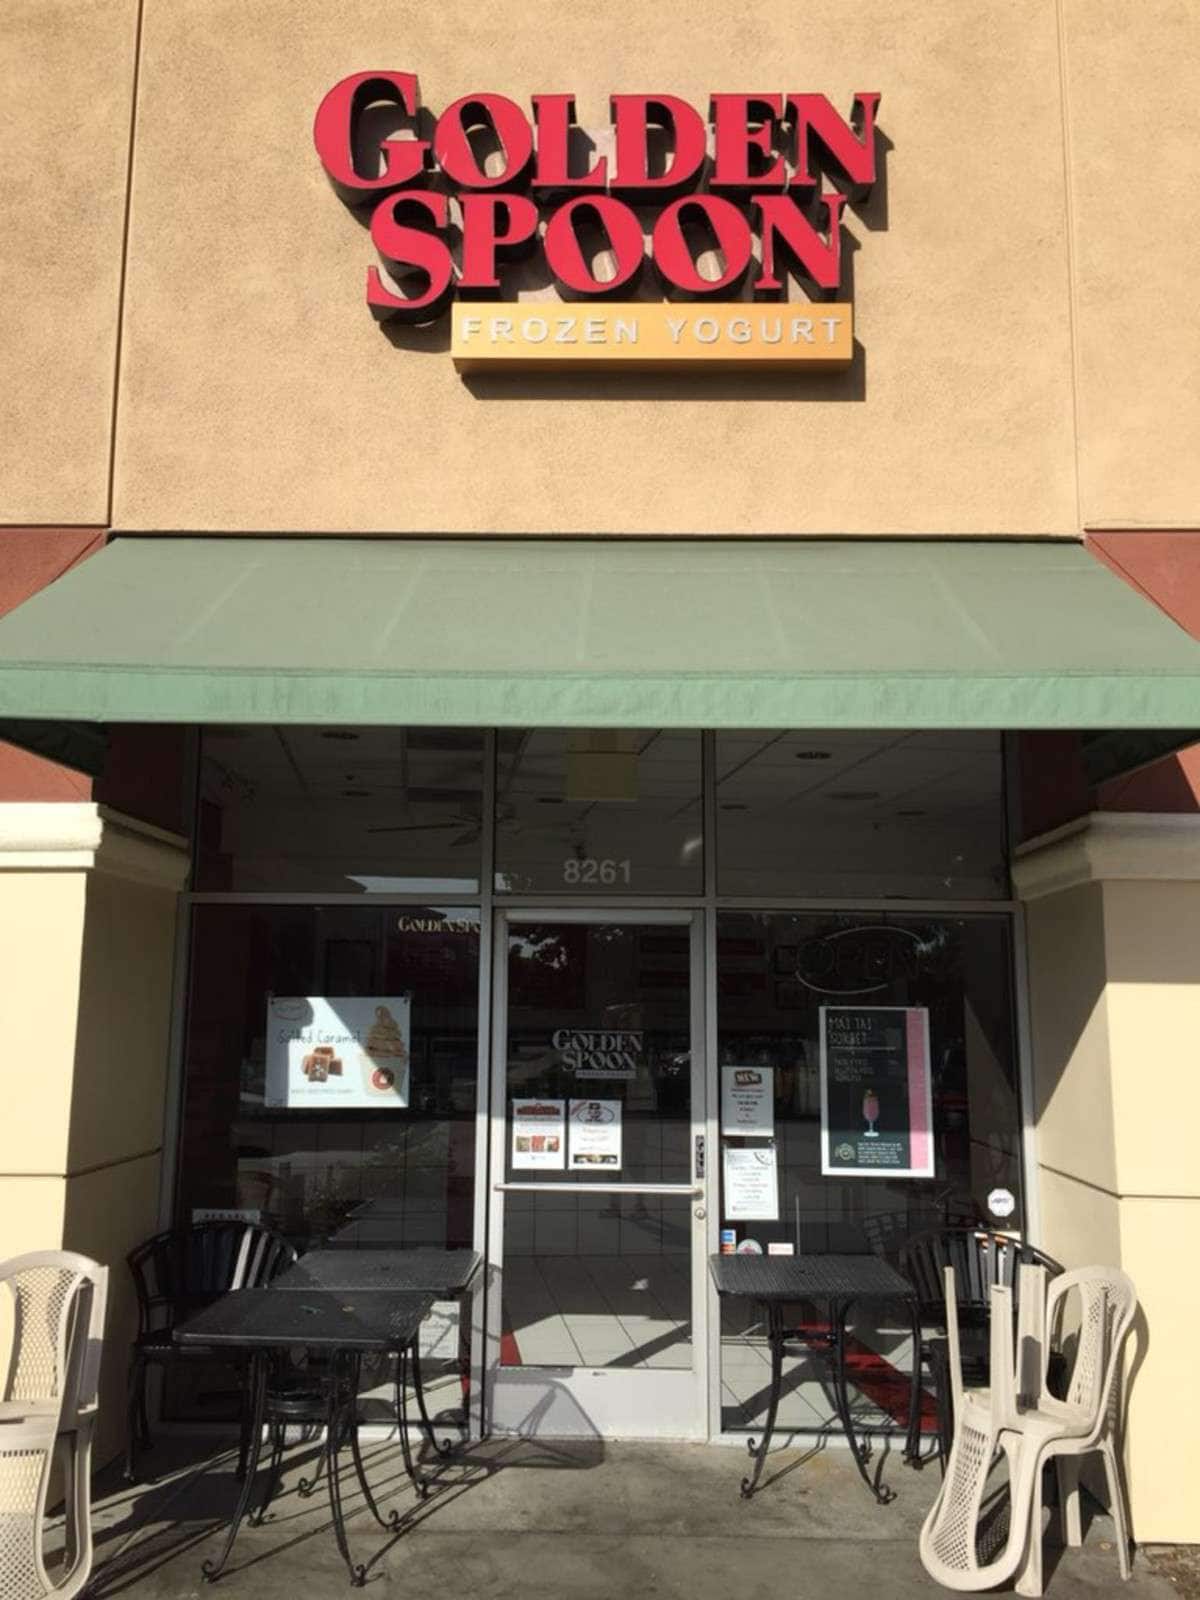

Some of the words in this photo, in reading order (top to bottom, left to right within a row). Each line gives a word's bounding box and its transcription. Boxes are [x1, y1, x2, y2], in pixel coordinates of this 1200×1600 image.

[313, 70, 881, 190] GOLDEN
[366, 190, 847, 309] SPOON
[461, 316, 639, 344] FROZEN
[667, 316, 843, 344] YOGURT
[563, 858, 632, 885] 8261
[551, 1028, 642, 1052] GOLDEN
[561, 1050, 637, 1072] SPOON
